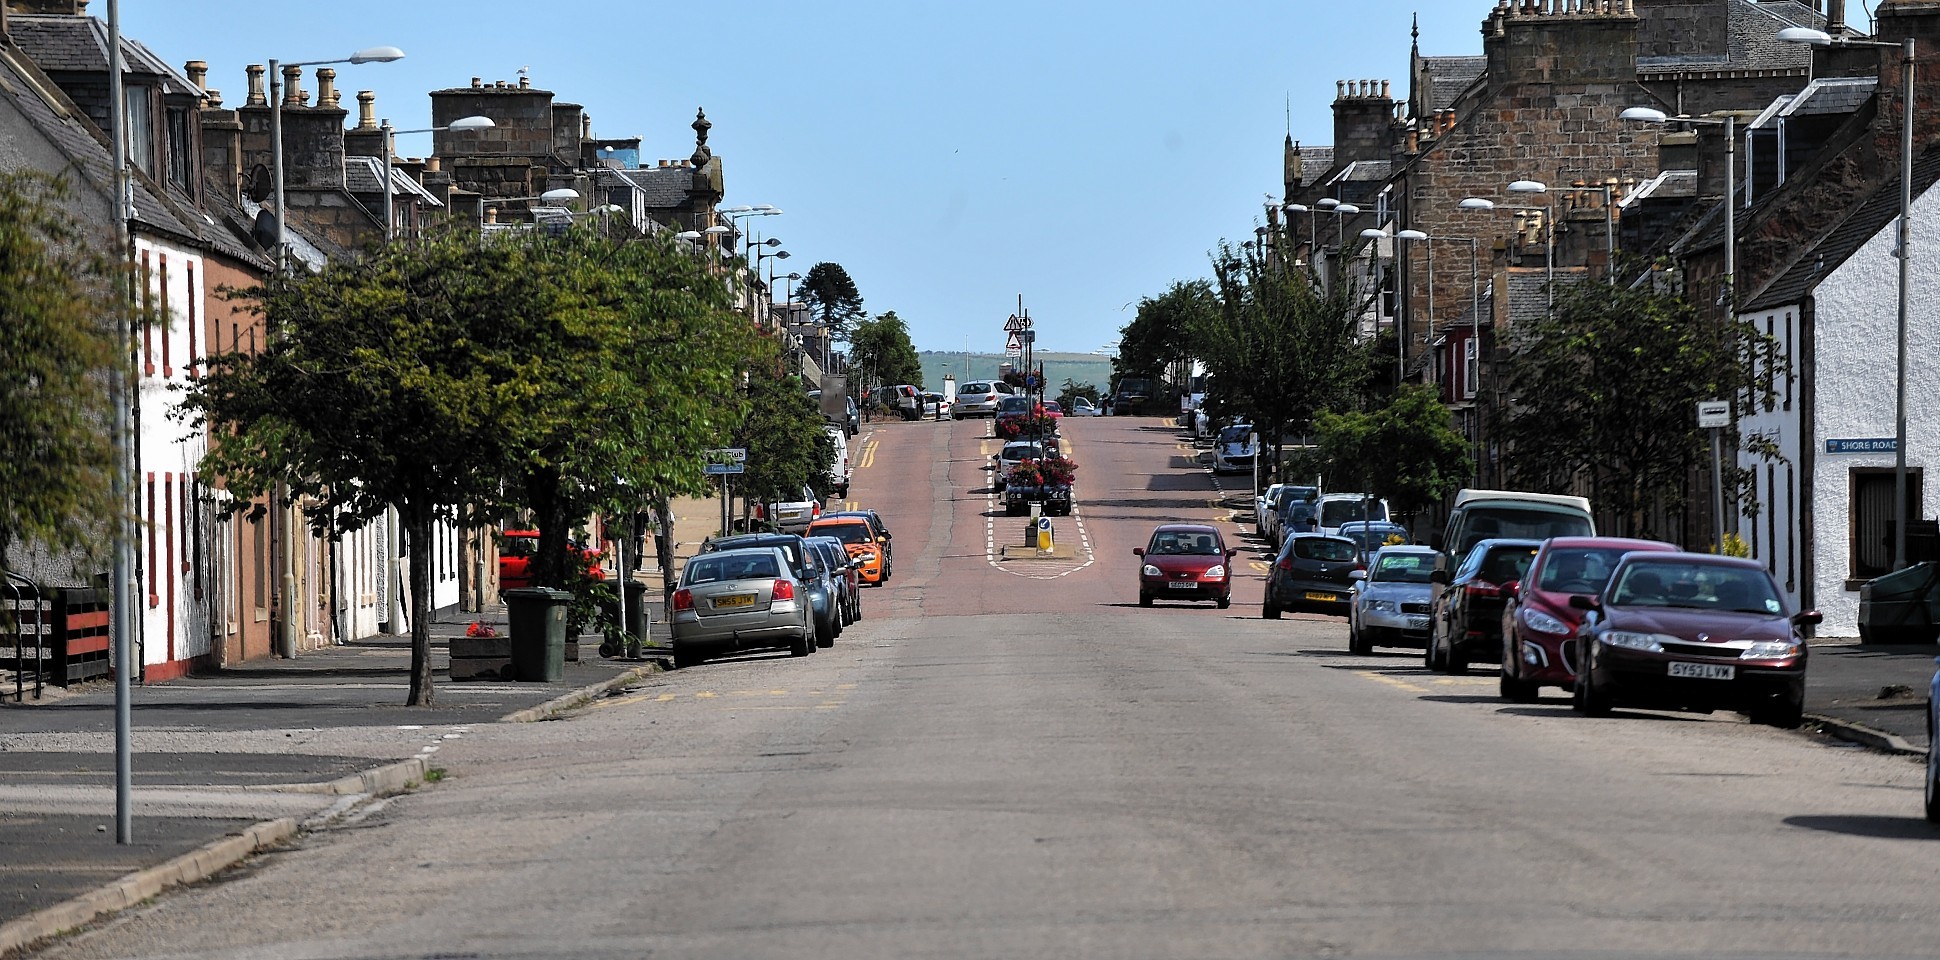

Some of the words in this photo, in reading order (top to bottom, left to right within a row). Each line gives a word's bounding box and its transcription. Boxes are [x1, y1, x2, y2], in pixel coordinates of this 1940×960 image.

[1841, 441, 1870, 450] SHORE
[1872, 440, 1898, 450] ROAD
[1673, 663, 1703, 677] SY53
